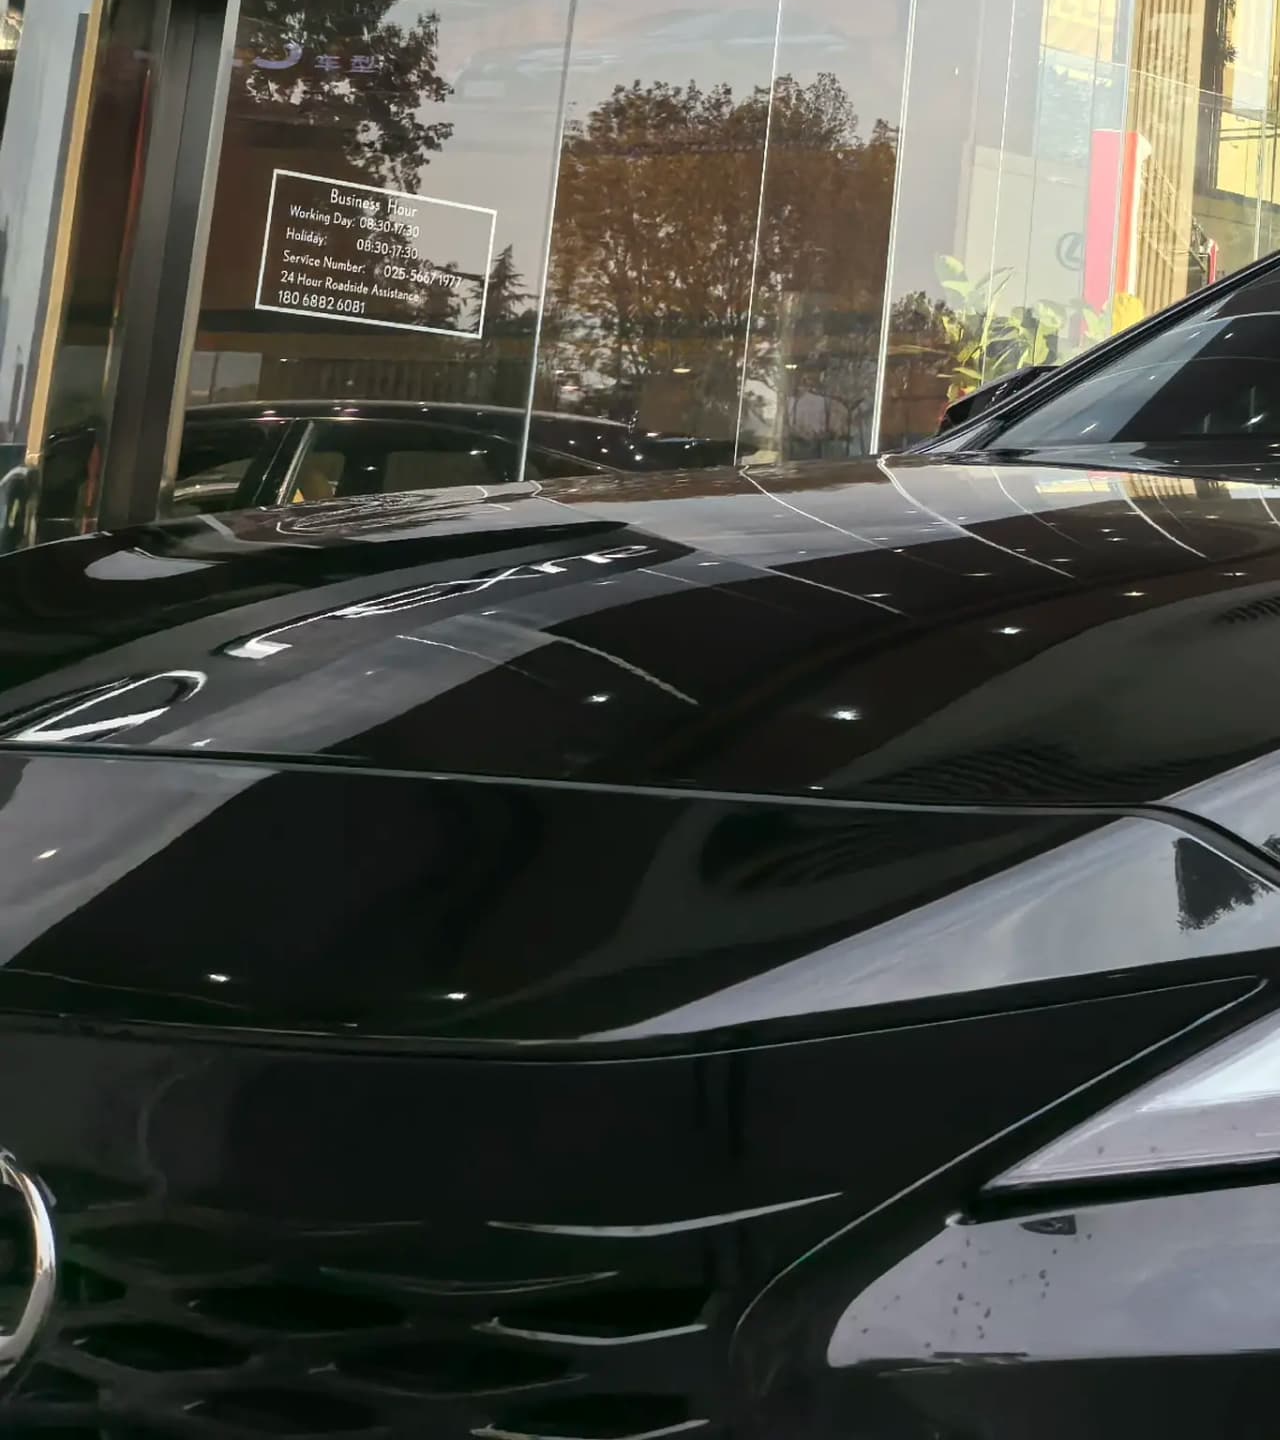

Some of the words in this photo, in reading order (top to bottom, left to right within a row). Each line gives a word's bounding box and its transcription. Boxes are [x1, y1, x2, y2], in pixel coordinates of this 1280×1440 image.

[330, 188, 381, 212] Business
[387, 198, 418, 218] Hour
[289, 204, 331, 225] Working
[333, 212, 356, 229] Day:
[359, 216, 420, 238] 08:30-17:30
[286, 227, 328, 246] Holiday:
[356, 238, 418, 259] 08:30-17:30
[282, 249, 321, 268] Service
[323, 257, 366, 274] Number:
[280, 270, 295, 284] 24
[297, 272, 322, 287] Hour
[324, 276, 369, 294] Roadside
[370, 284, 420, 302] Assistance
[278, 290, 300, 305] 180
[302, 293, 335, 310] 6882
[336, 298, 366, 314] 6081
